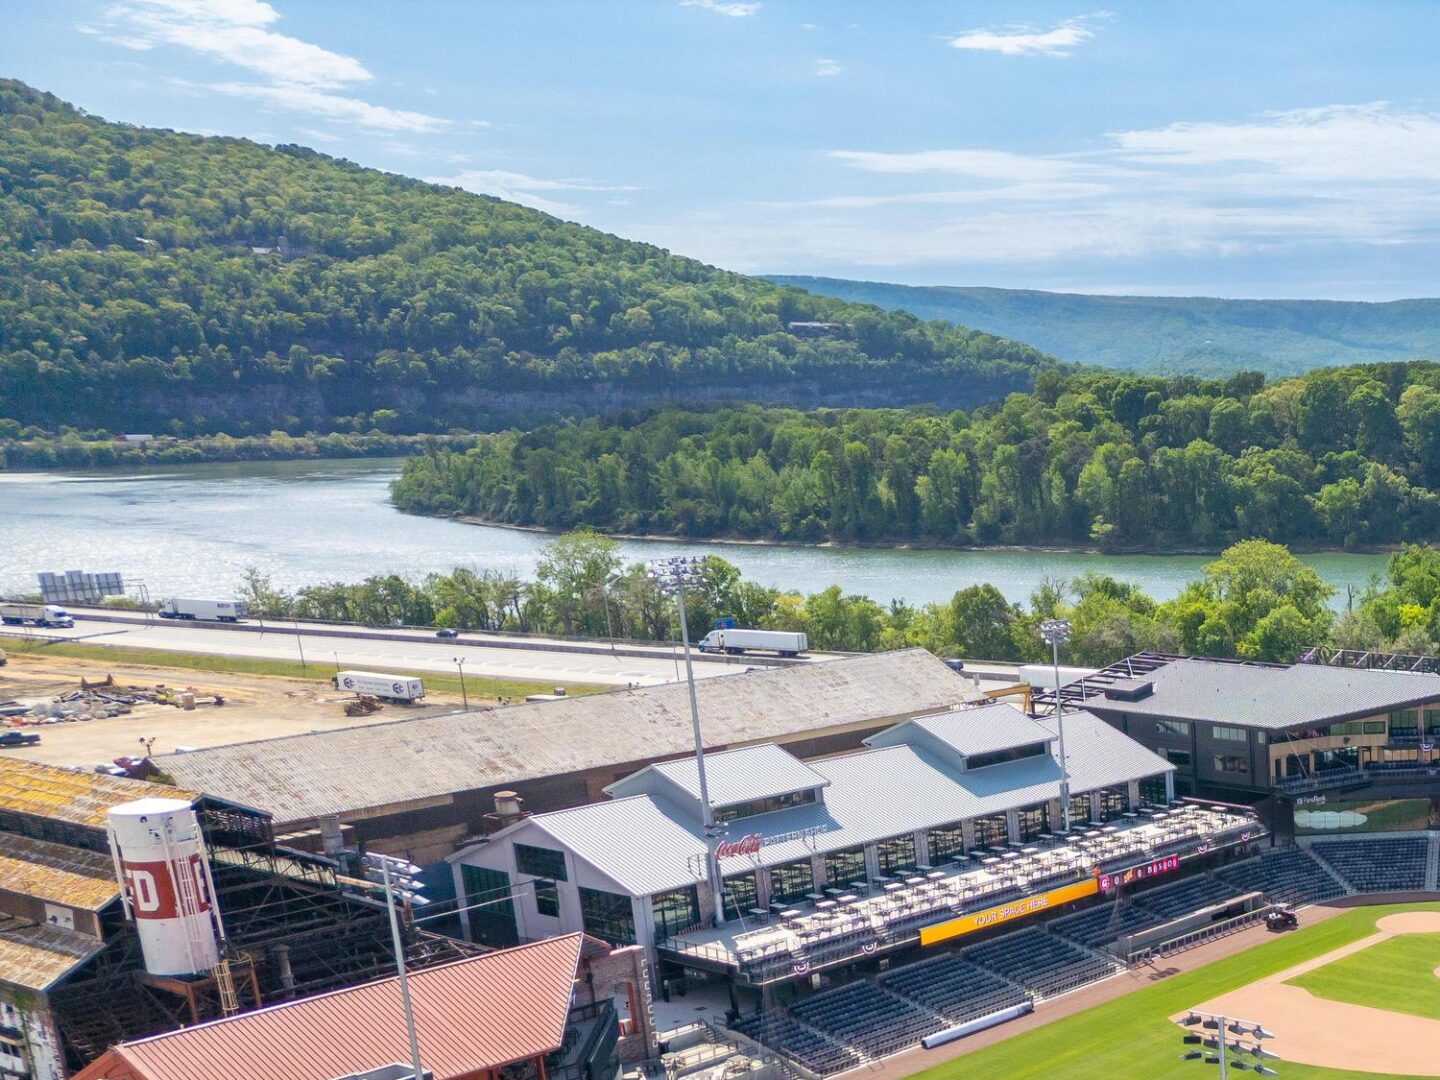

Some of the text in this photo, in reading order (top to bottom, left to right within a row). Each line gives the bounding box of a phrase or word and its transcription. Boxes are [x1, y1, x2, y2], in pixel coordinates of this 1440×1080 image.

[715, 833, 761, 860] Coca-Cola
[974, 898, 1049, 926] YOUR SPACE HERE
